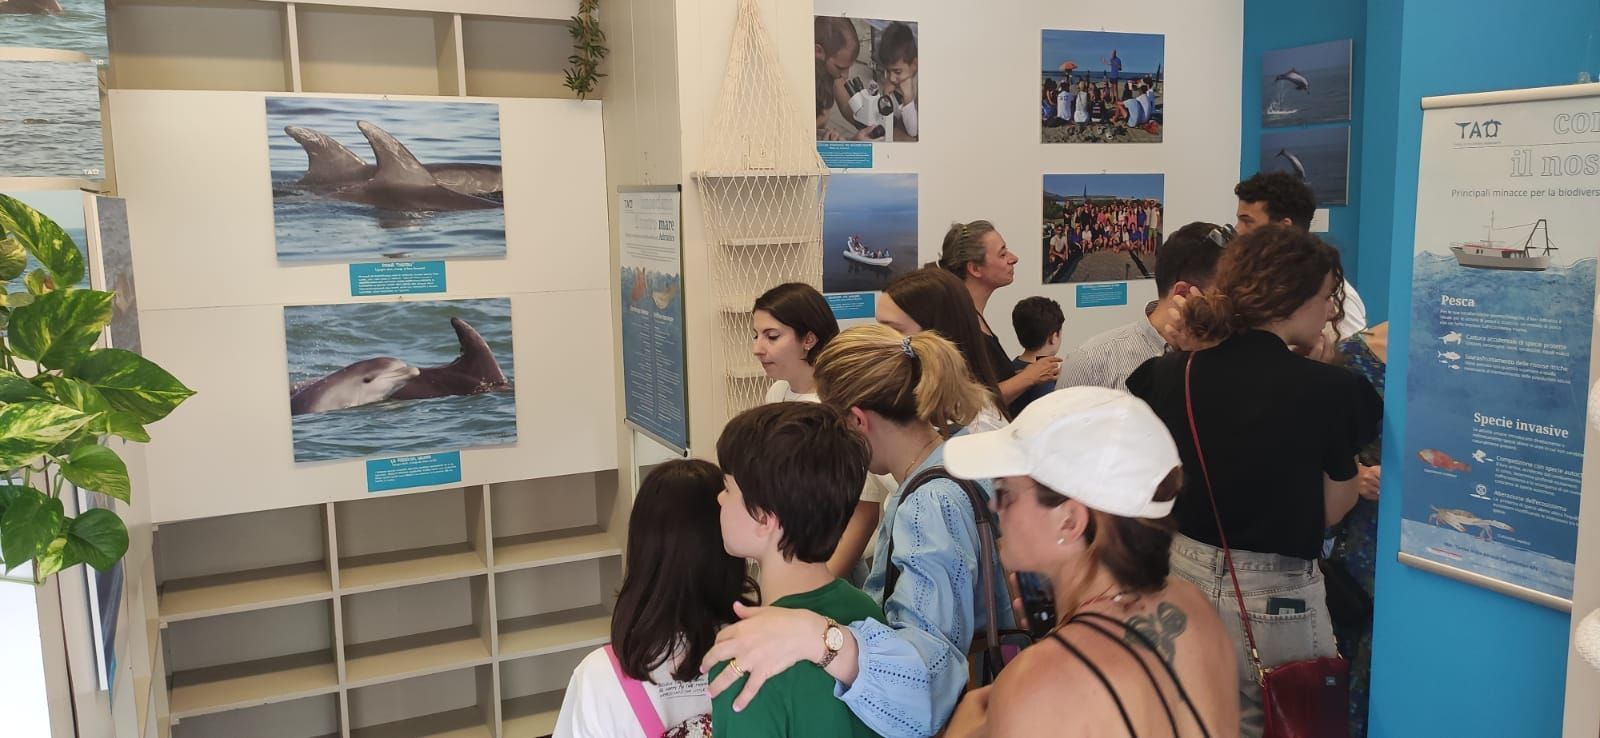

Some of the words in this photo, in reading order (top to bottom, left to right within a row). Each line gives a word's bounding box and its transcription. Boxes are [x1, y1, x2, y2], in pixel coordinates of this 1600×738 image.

[1455, 119, 1502, 139] TAO
[1510, 150, 1533, 177] il
[1451, 189, 1490, 198] Principali
[1493, 188, 1528, 197] minacce
[1530, 189, 1545, 198] per
[1548, 187, 1556, 197] la
[1440, 294, 1475, 307] Pesca
[1473, 412, 1513, 429] Specie
[1516, 418, 1569, 438] invasive
